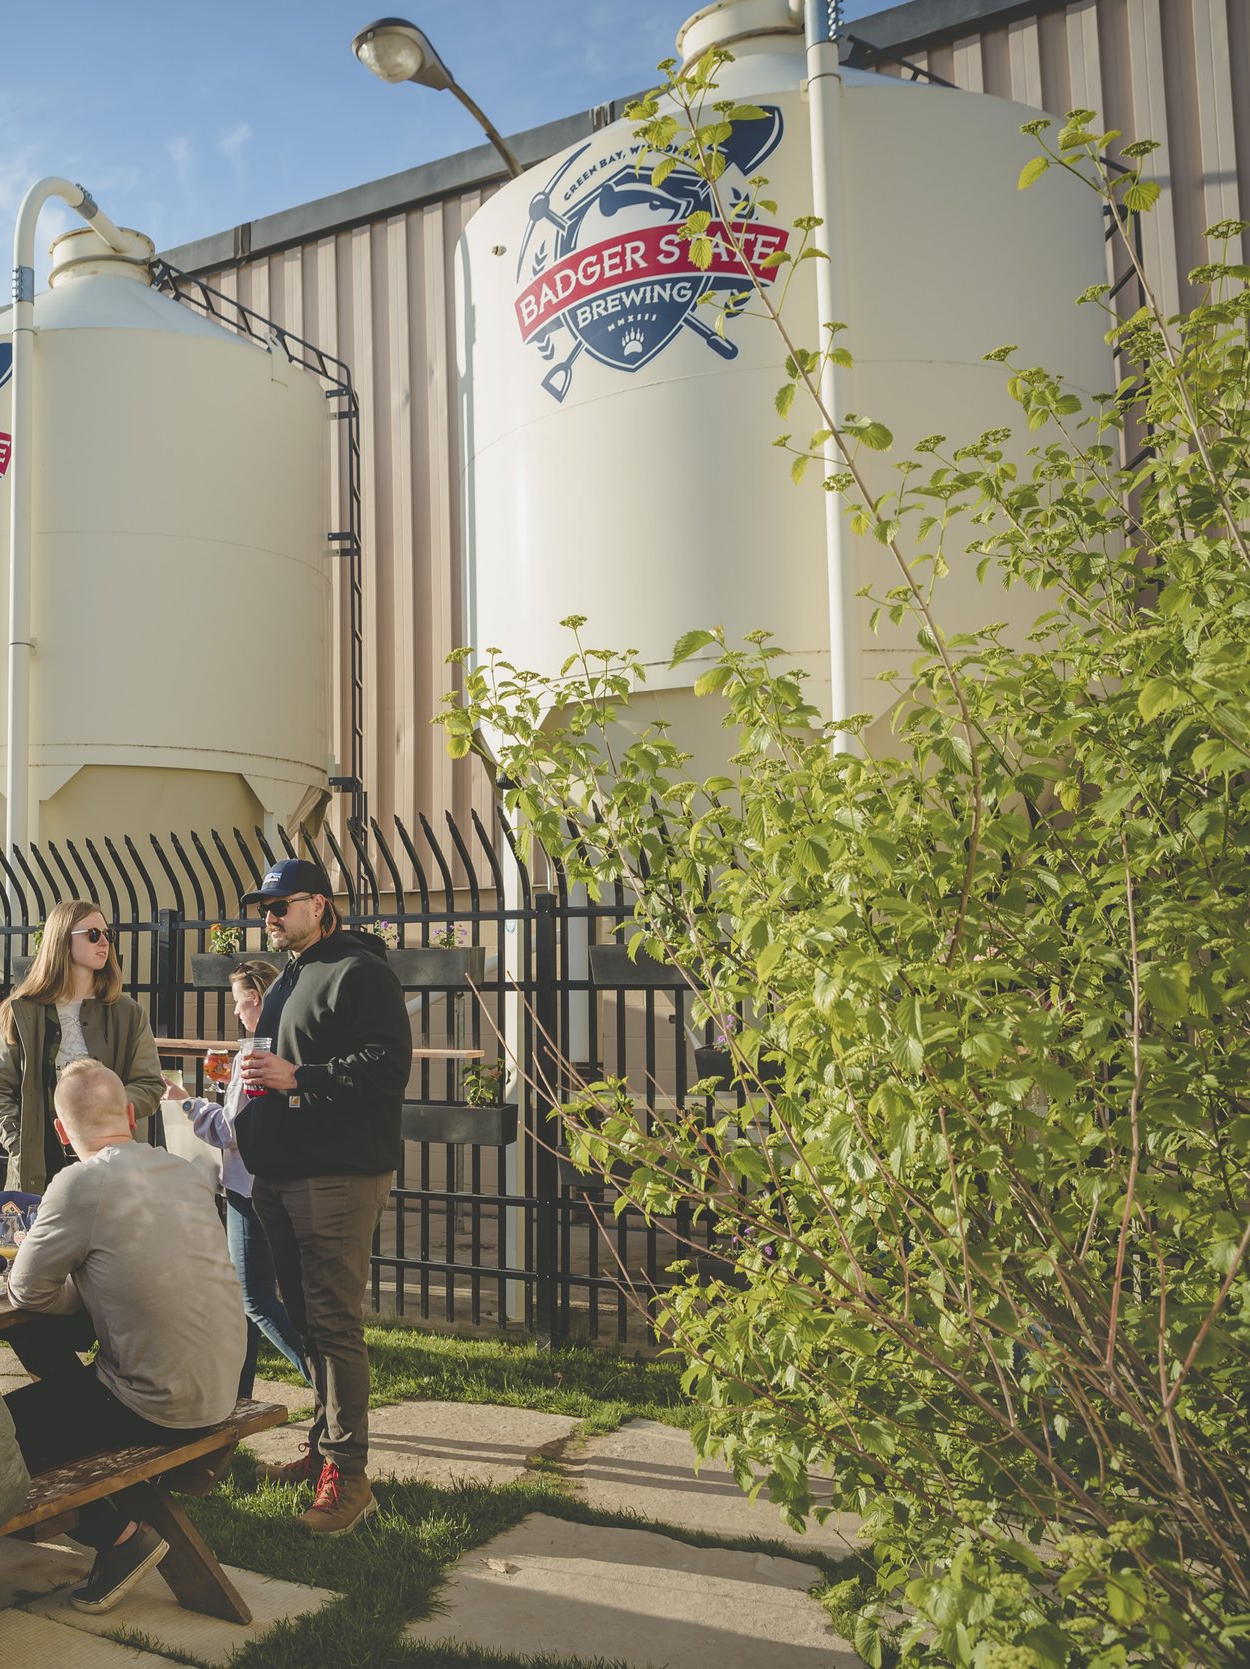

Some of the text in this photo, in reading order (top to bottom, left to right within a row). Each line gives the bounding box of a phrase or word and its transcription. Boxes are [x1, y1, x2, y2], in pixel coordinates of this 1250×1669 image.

[563, 164, 598, 201] GREEN
[599, 150, 627, 170] BAY,
[520, 240, 648, 328] BADGER
[576, 281, 693, 330] BREWING
